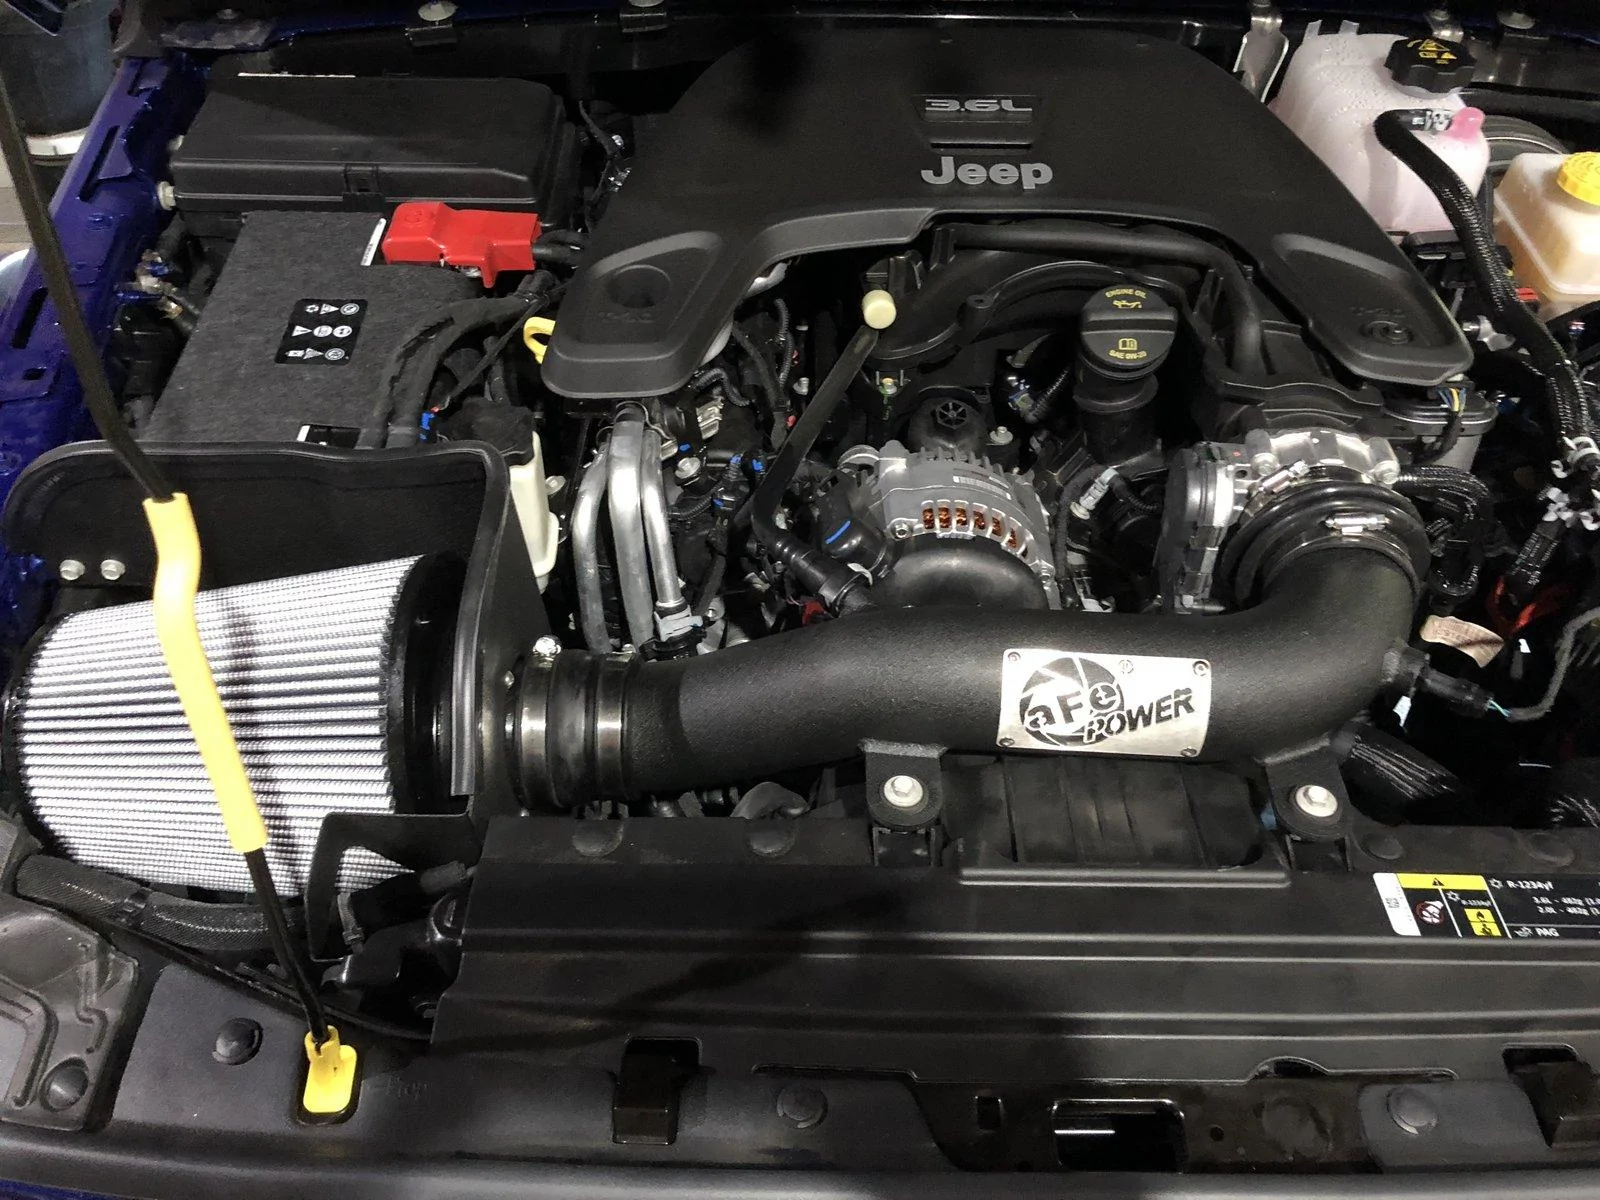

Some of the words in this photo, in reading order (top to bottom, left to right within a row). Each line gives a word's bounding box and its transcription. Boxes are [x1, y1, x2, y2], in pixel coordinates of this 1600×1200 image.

[925, 99, 1033, 112] 3.6L
[921, 156, 1053, 190] Jeep
[1105, 288, 1133, 298] ENGINE
[1135, 289, 1147, 299] OIL
[1108, 350, 1124, 359] SAE
[1125, 351, 1147, 360] 0W-20
[1085, 687, 1195, 743] POWER
[1507, 880, 1554, 891] R-1234yf
[1535, 927, 1560, 937] PAG
